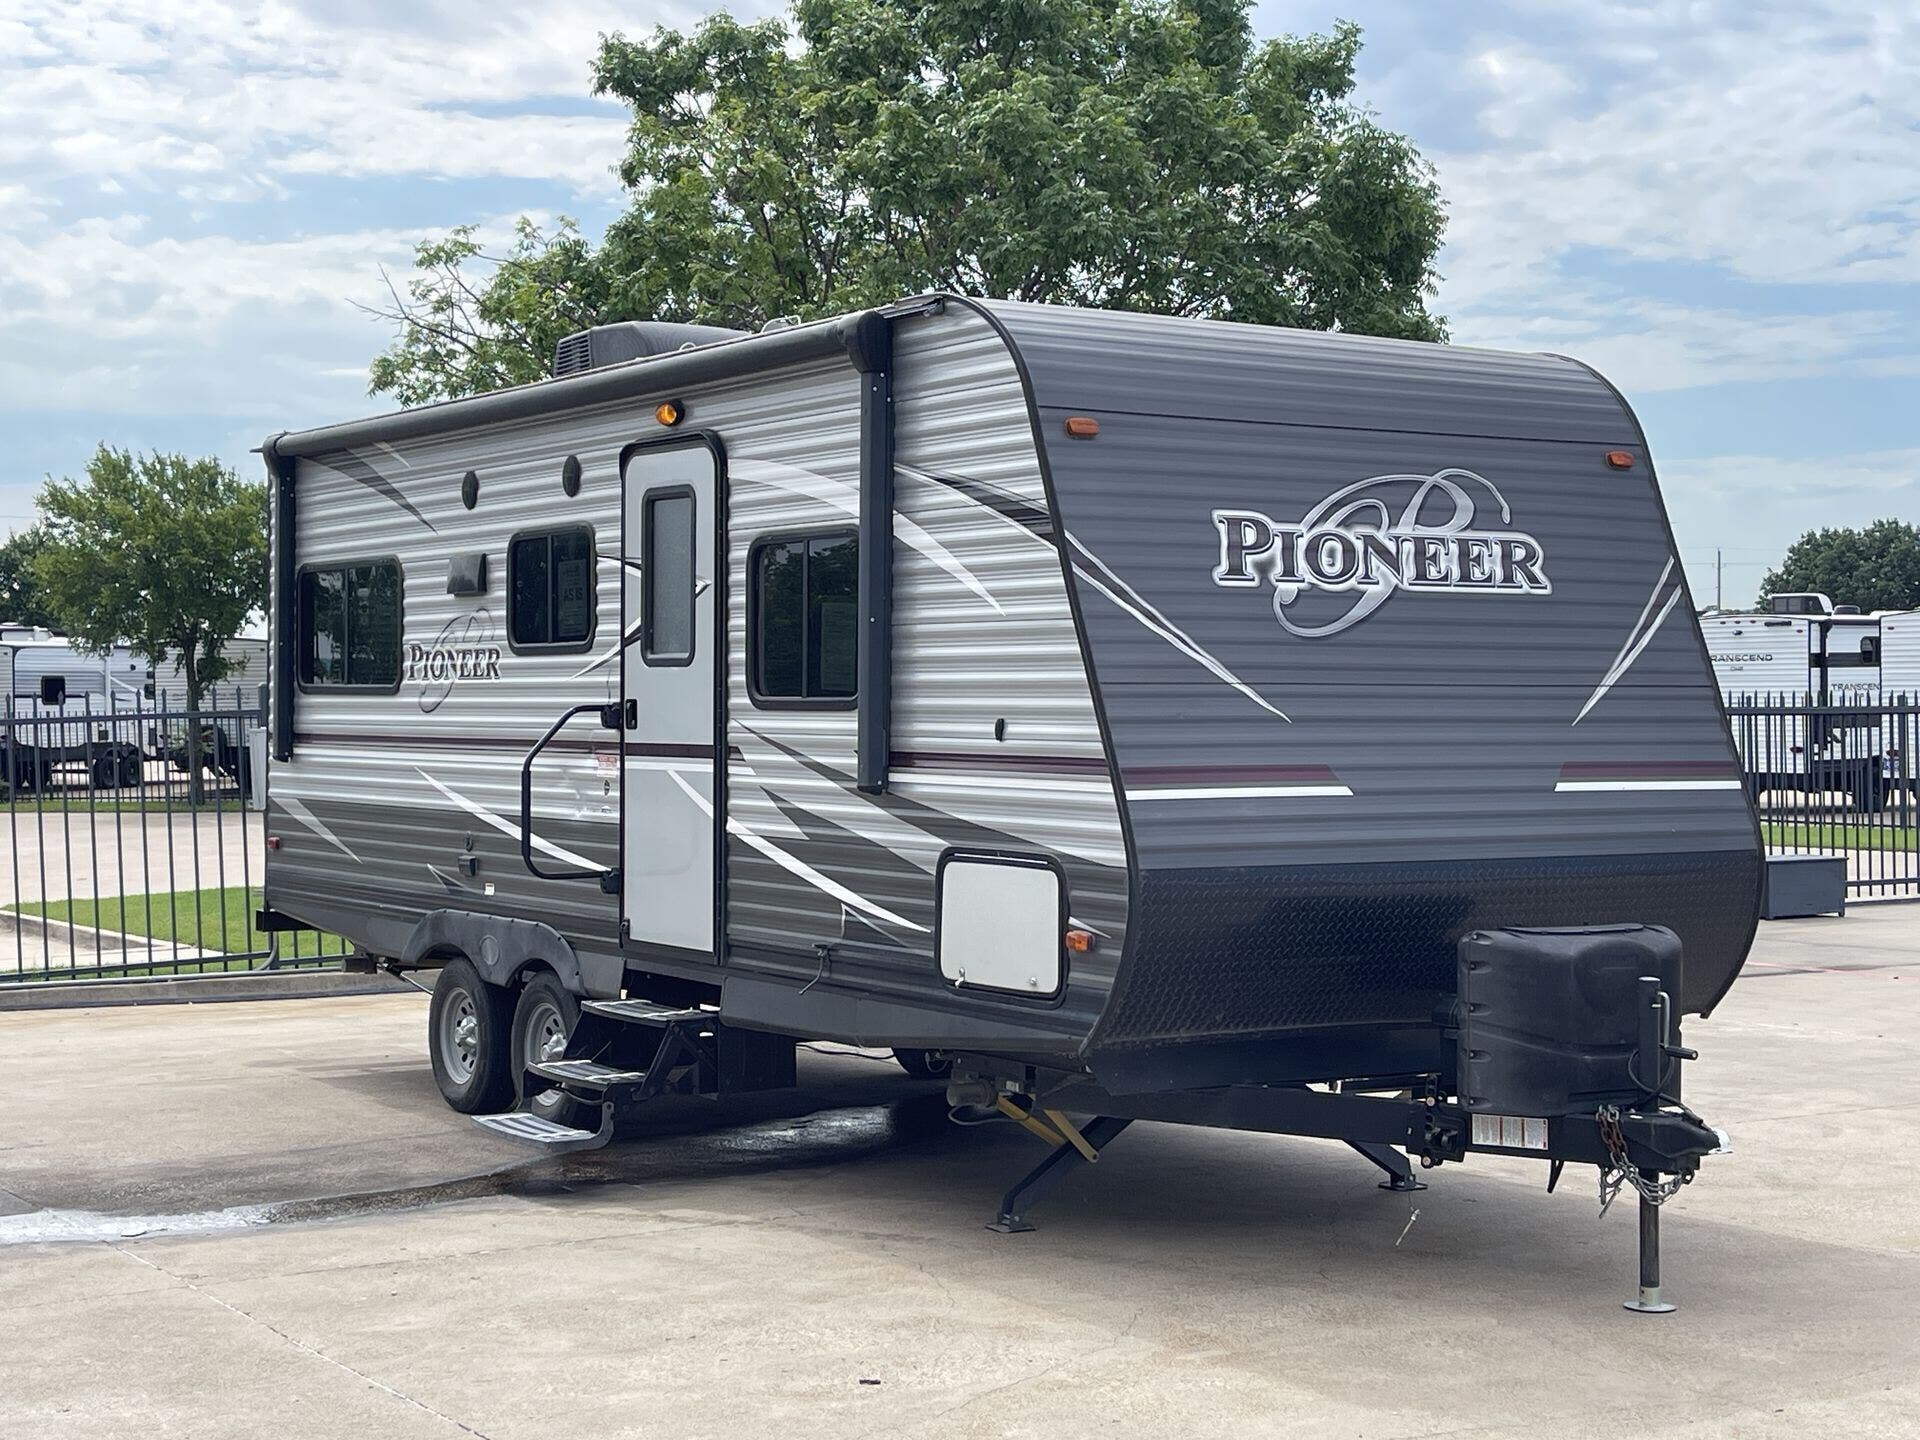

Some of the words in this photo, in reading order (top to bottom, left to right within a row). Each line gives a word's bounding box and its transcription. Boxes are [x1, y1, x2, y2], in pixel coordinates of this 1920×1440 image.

[1213, 511, 1551, 592] PIONEER
[407, 642, 501, 681] PIONEER
[1710, 654, 1773, 662] RANSCEND
[1832, 683, 1880, 691] TRANSCEN
